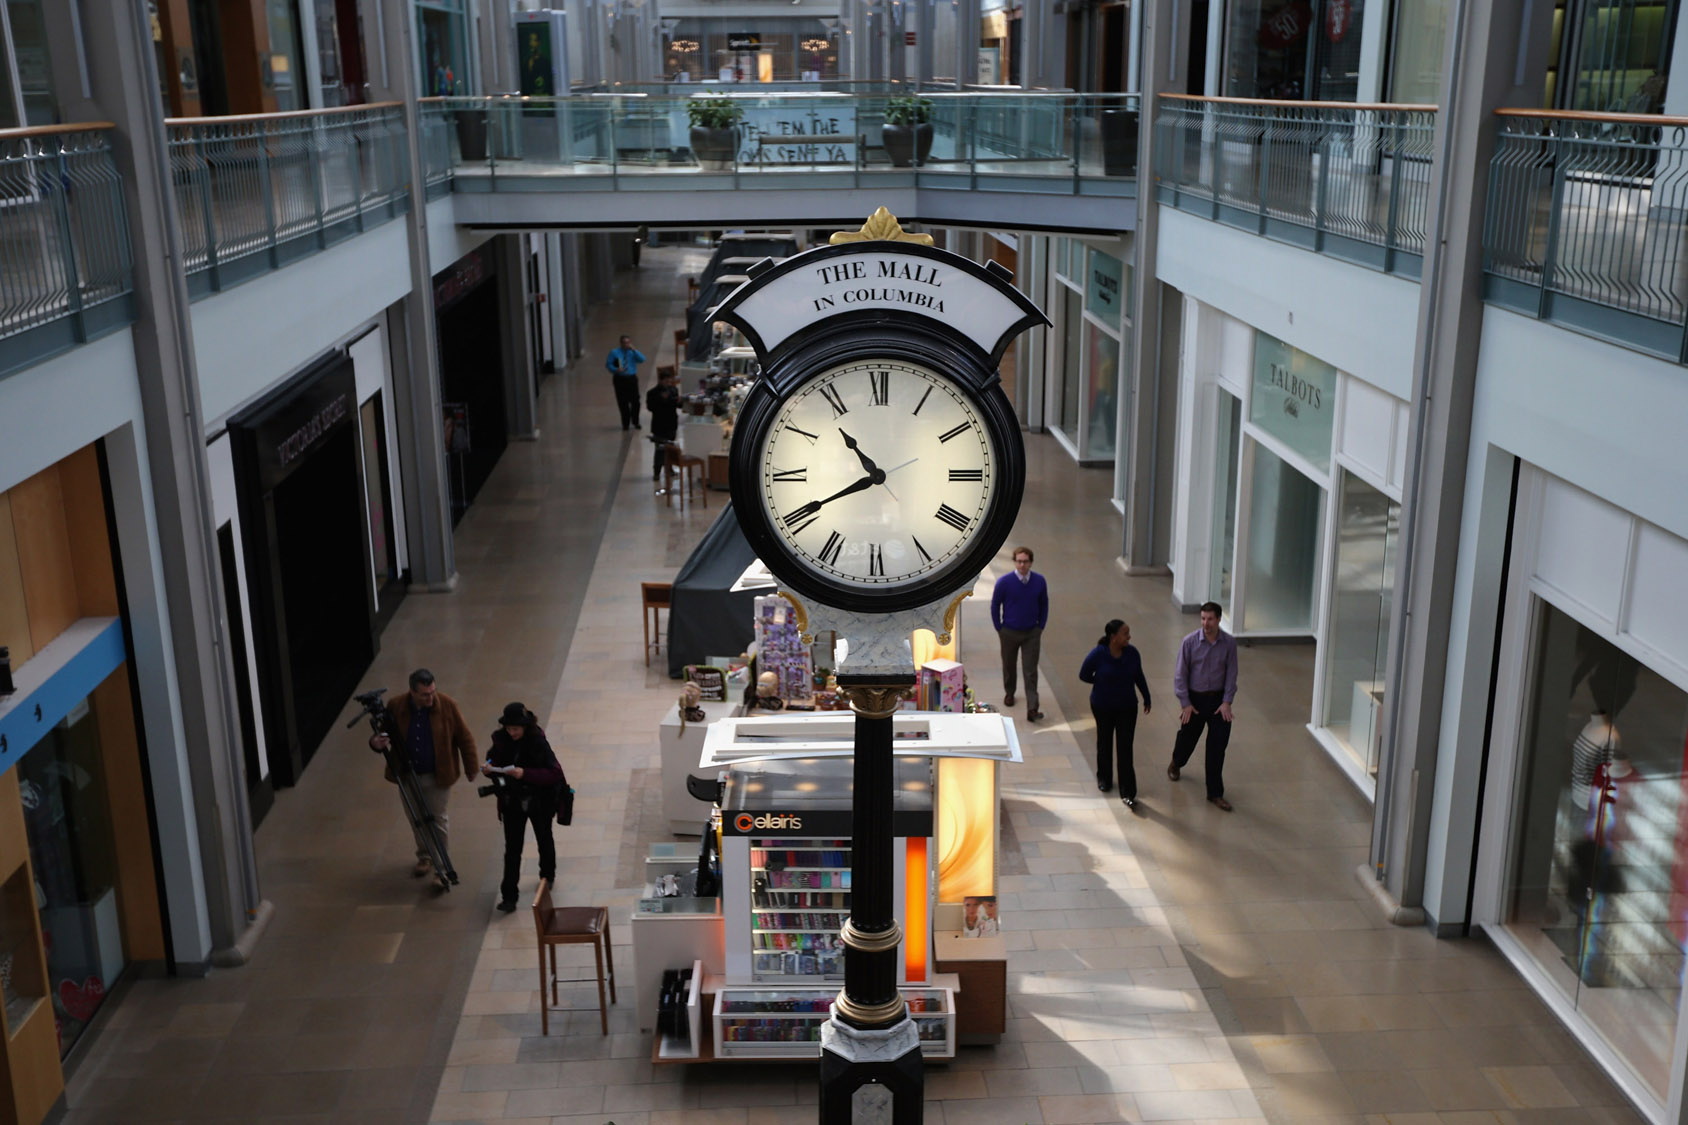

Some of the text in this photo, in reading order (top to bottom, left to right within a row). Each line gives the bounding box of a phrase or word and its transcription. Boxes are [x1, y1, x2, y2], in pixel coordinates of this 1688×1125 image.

[825, 145, 847, 161] YA
[816, 260, 943, 287] THE MALL
[813, 288, 945, 313] IN COLUMBIA
[868, 371, 890, 406] XII
[1270, 362, 1321, 410] TALBOTS
[818, 382, 850, 420] XI
[773, 466, 807, 483] IX
[948, 469, 983, 482] III
